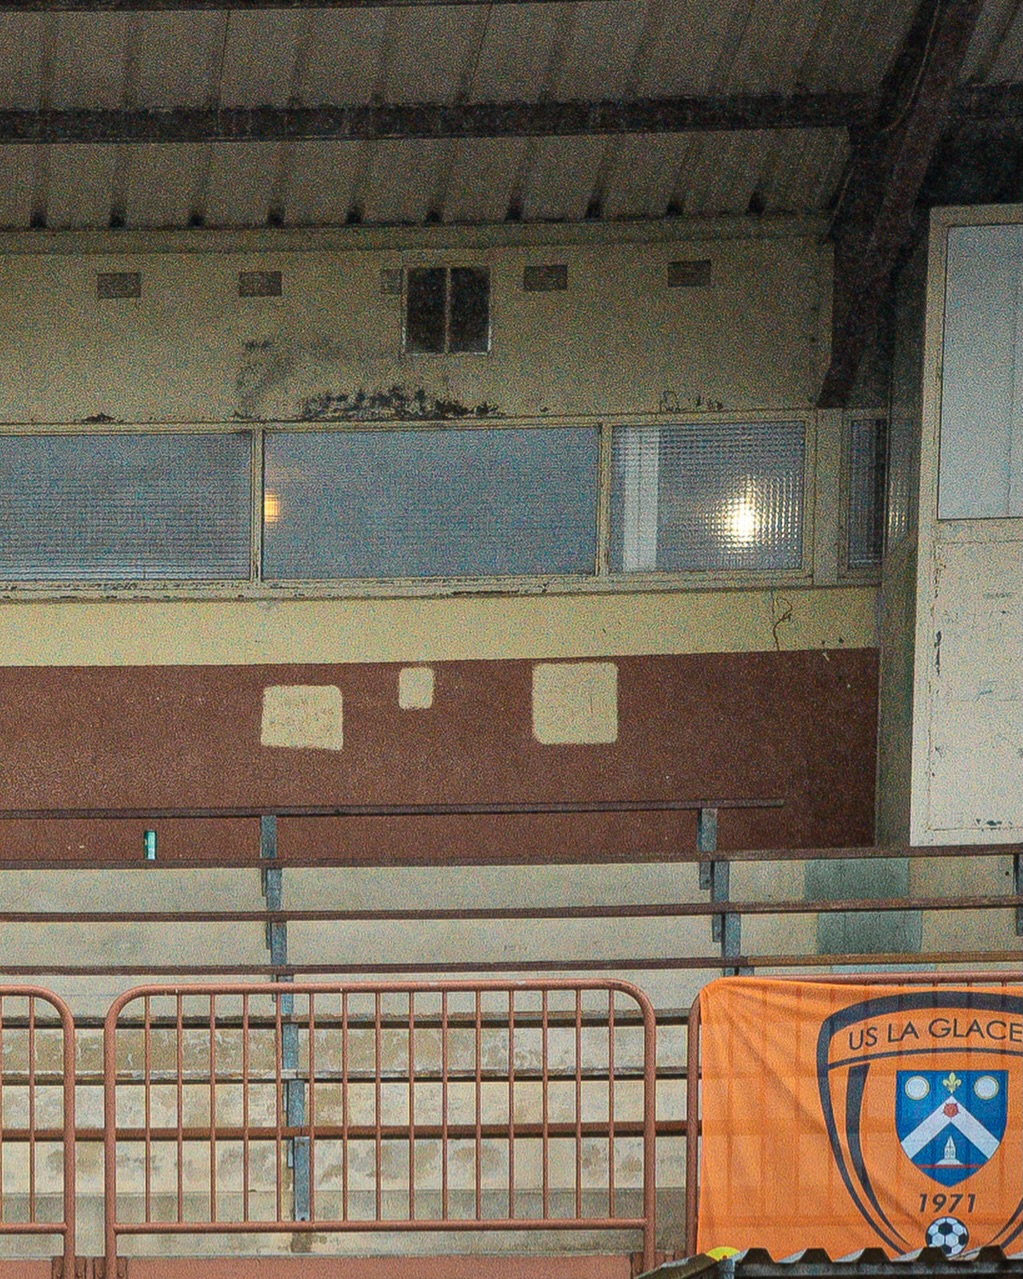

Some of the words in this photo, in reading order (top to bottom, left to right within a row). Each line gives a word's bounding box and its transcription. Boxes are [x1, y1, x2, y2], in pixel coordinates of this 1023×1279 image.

[849, 1026, 877, 1050] US
[887, 1021, 920, 1043] LA
[919, 1193, 976, 1214] 1971
